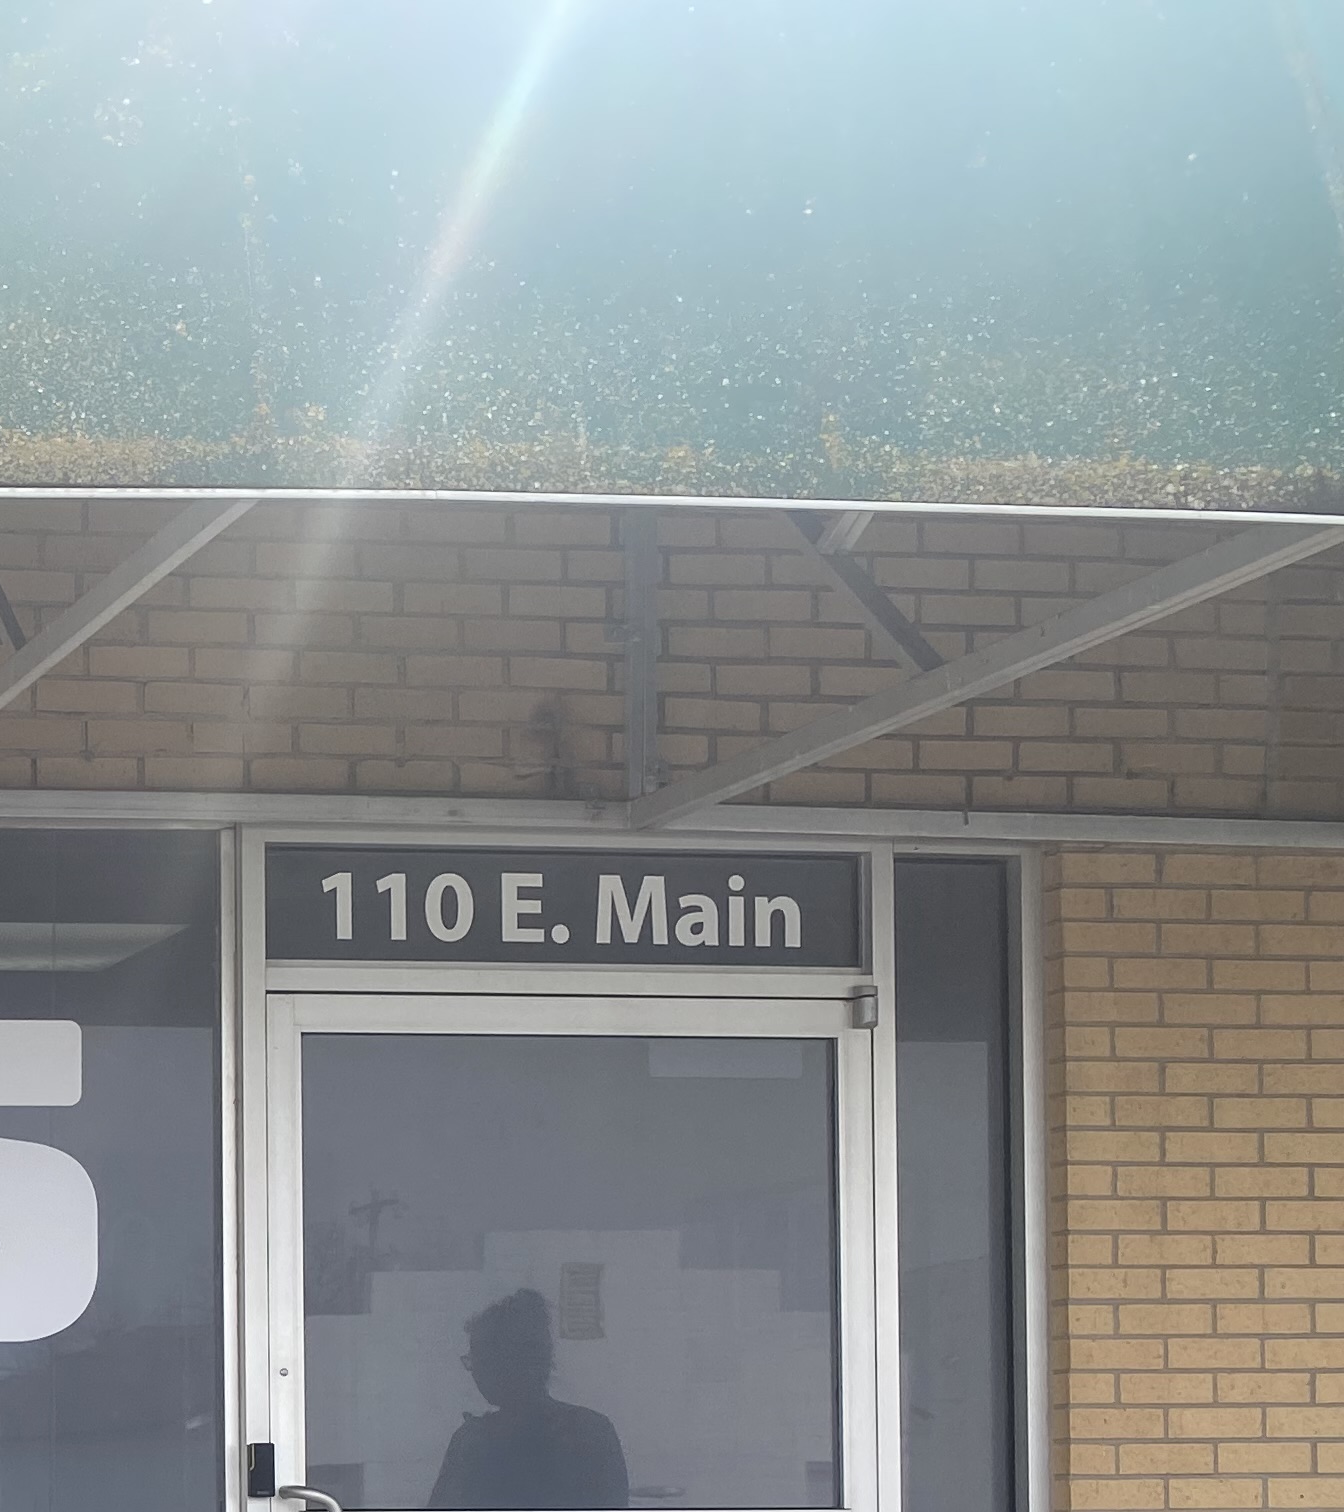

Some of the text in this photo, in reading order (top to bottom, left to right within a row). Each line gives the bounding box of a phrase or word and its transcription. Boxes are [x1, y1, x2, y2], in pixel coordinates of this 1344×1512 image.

[321, 872, 802, 948] 110 E. Main
